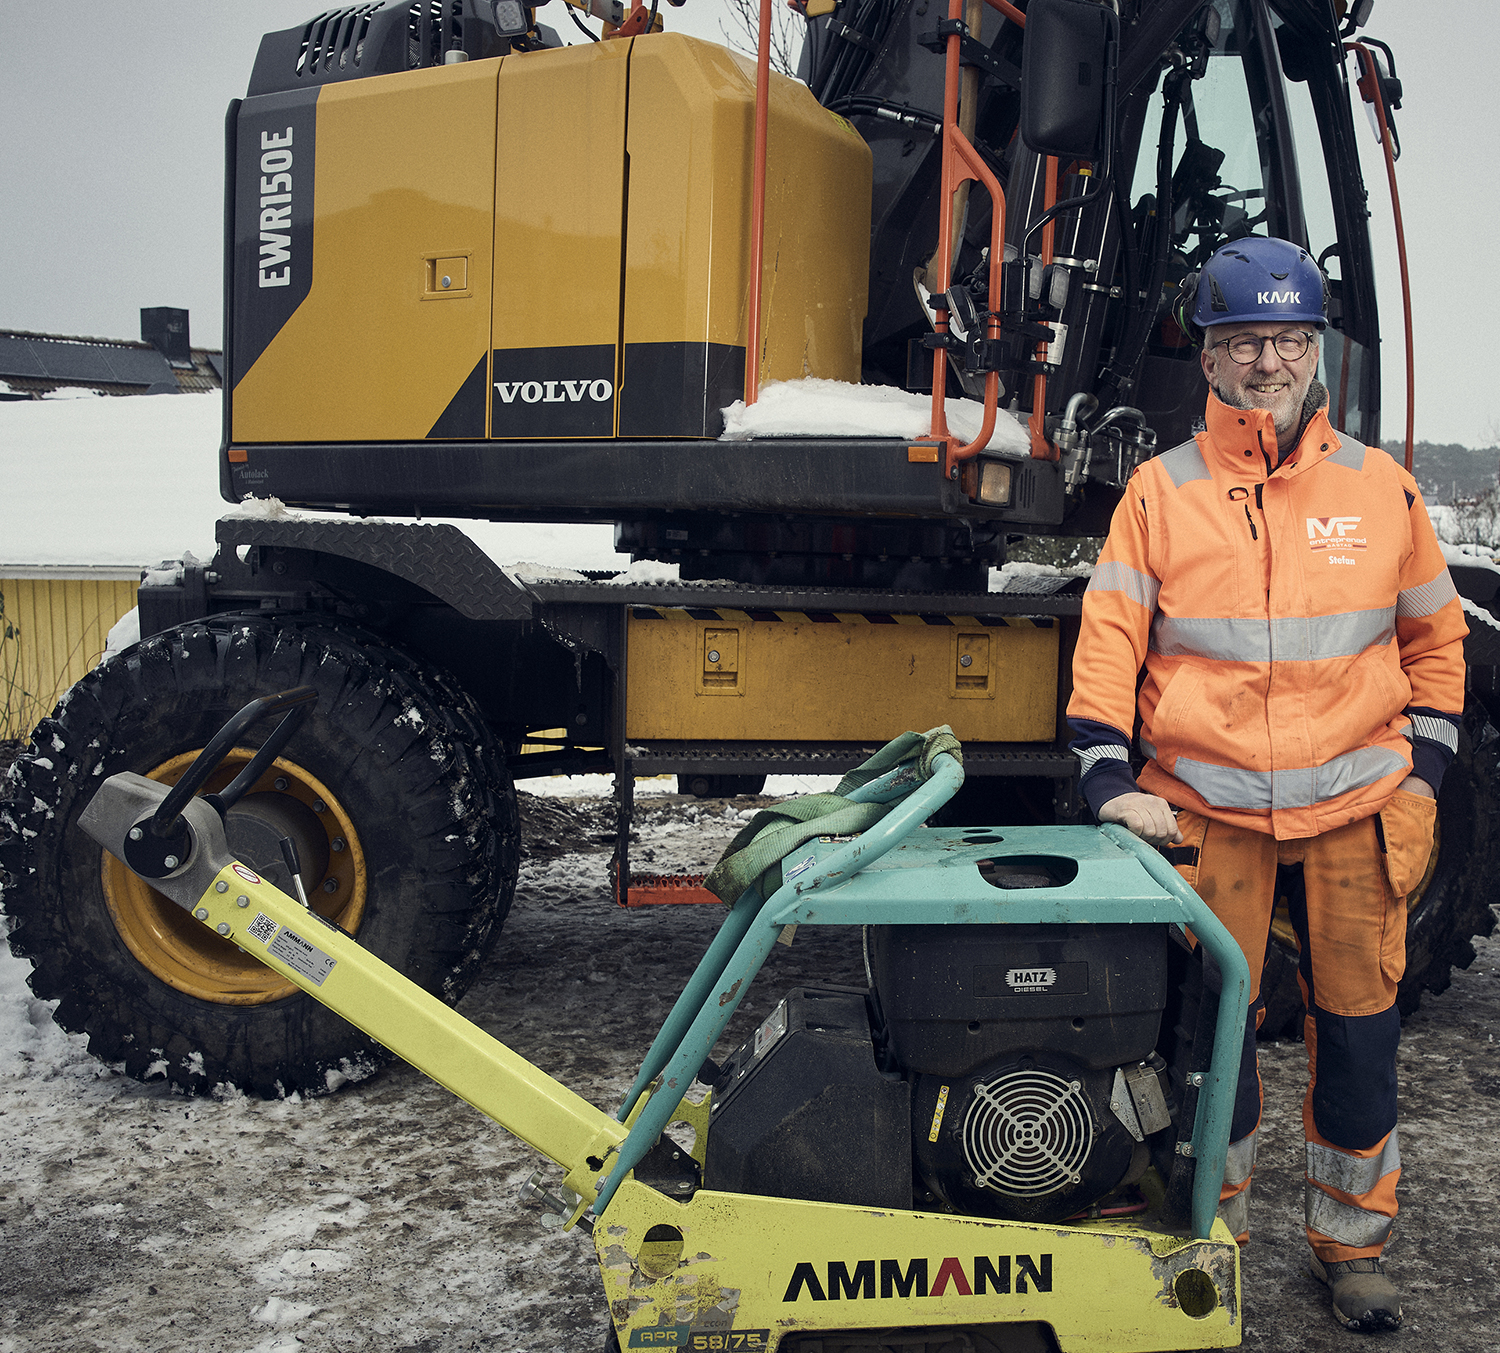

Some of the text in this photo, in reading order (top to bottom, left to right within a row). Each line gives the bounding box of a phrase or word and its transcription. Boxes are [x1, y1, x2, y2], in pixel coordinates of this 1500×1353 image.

[259, 127, 293, 288] EWR150E
[1257, 291, 1301, 304] KASK
[494, 379, 613, 403] VOLVO
[1306, 516, 1362, 539] MF
[1309, 537, 1367, 546] entreprenad
[1328, 555, 1355, 565] Stefan
[284, 930, 314, 953] AMMANN
[1014, 972, 1048, 983] HATZ
[782, 1253, 1053, 1302] AMMANN
[704, 1320, 728, 1328] econ
[640, 1331, 678, 1342] APR
[693, 1334, 761, 1350] 58/75
